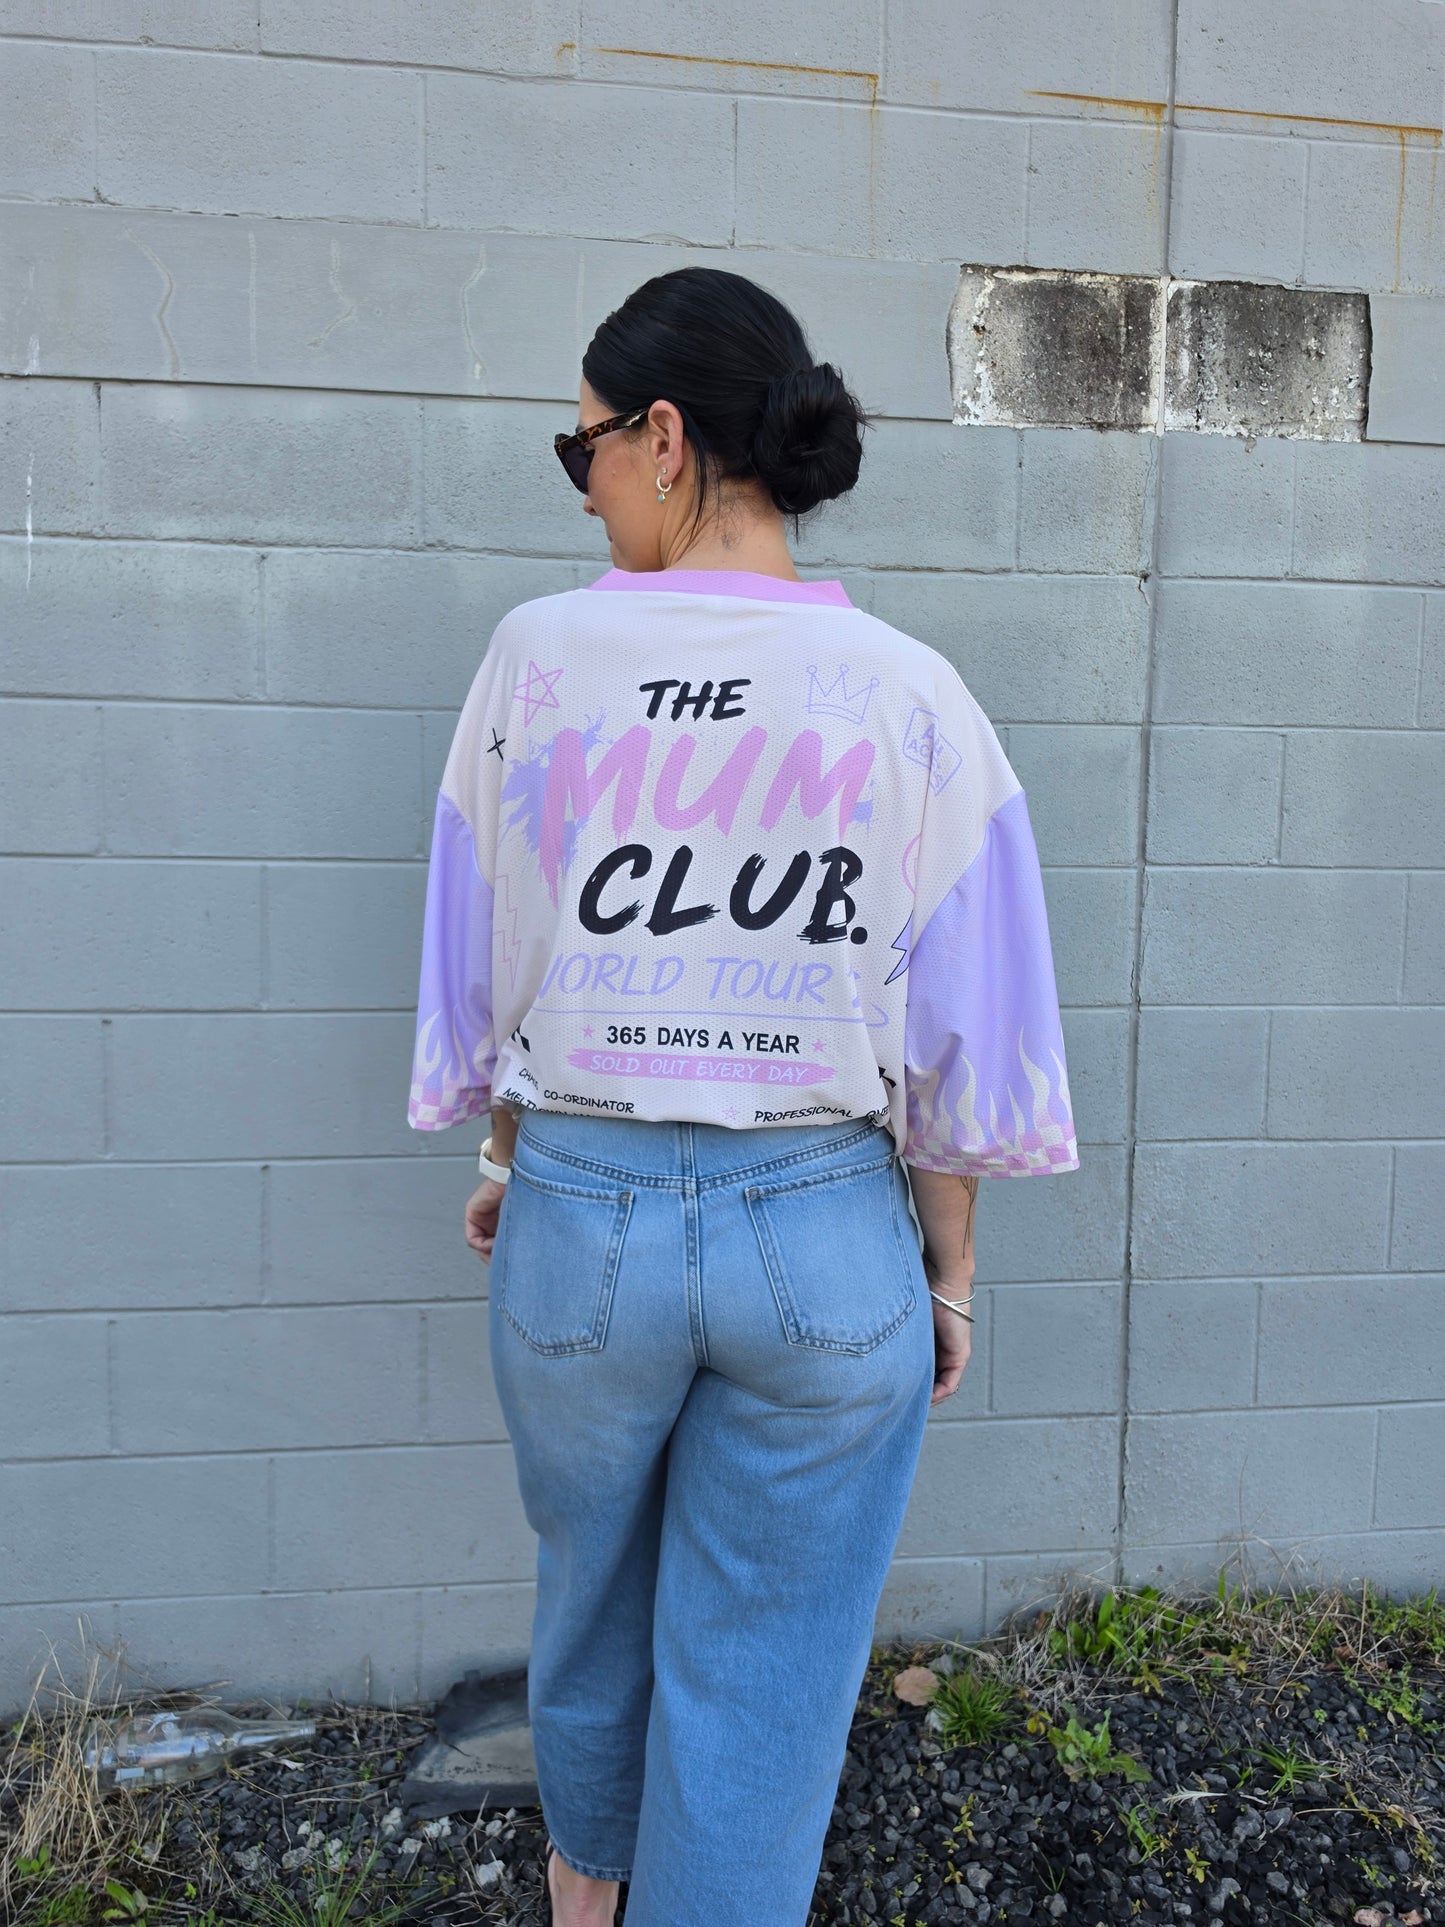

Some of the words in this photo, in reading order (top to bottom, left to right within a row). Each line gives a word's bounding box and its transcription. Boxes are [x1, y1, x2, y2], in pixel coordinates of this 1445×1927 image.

[639, 678, 752, 722] THE
[539, 724, 877, 908] MUM
[578, 843, 869, 945] CLUB.
[706, 956, 834, 1005] TOUR
[606, 1025, 647, 1046] 365
[657, 1027, 710, 1048] DAYS
[717, 1031, 734, 1050] A
[742, 1031, 800, 1054] YEAR
[590, 1054, 642, 1075] SOLD
[650, 1057, 690, 1076] OUT
[696, 1060, 761, 1080] EVERY
[768, 1063, 809, 1083] DAY
[543, 1089, 635, 1114] CO-ORDINATOR
[754, 1106, 854, 1123] PROFESSIONAL
